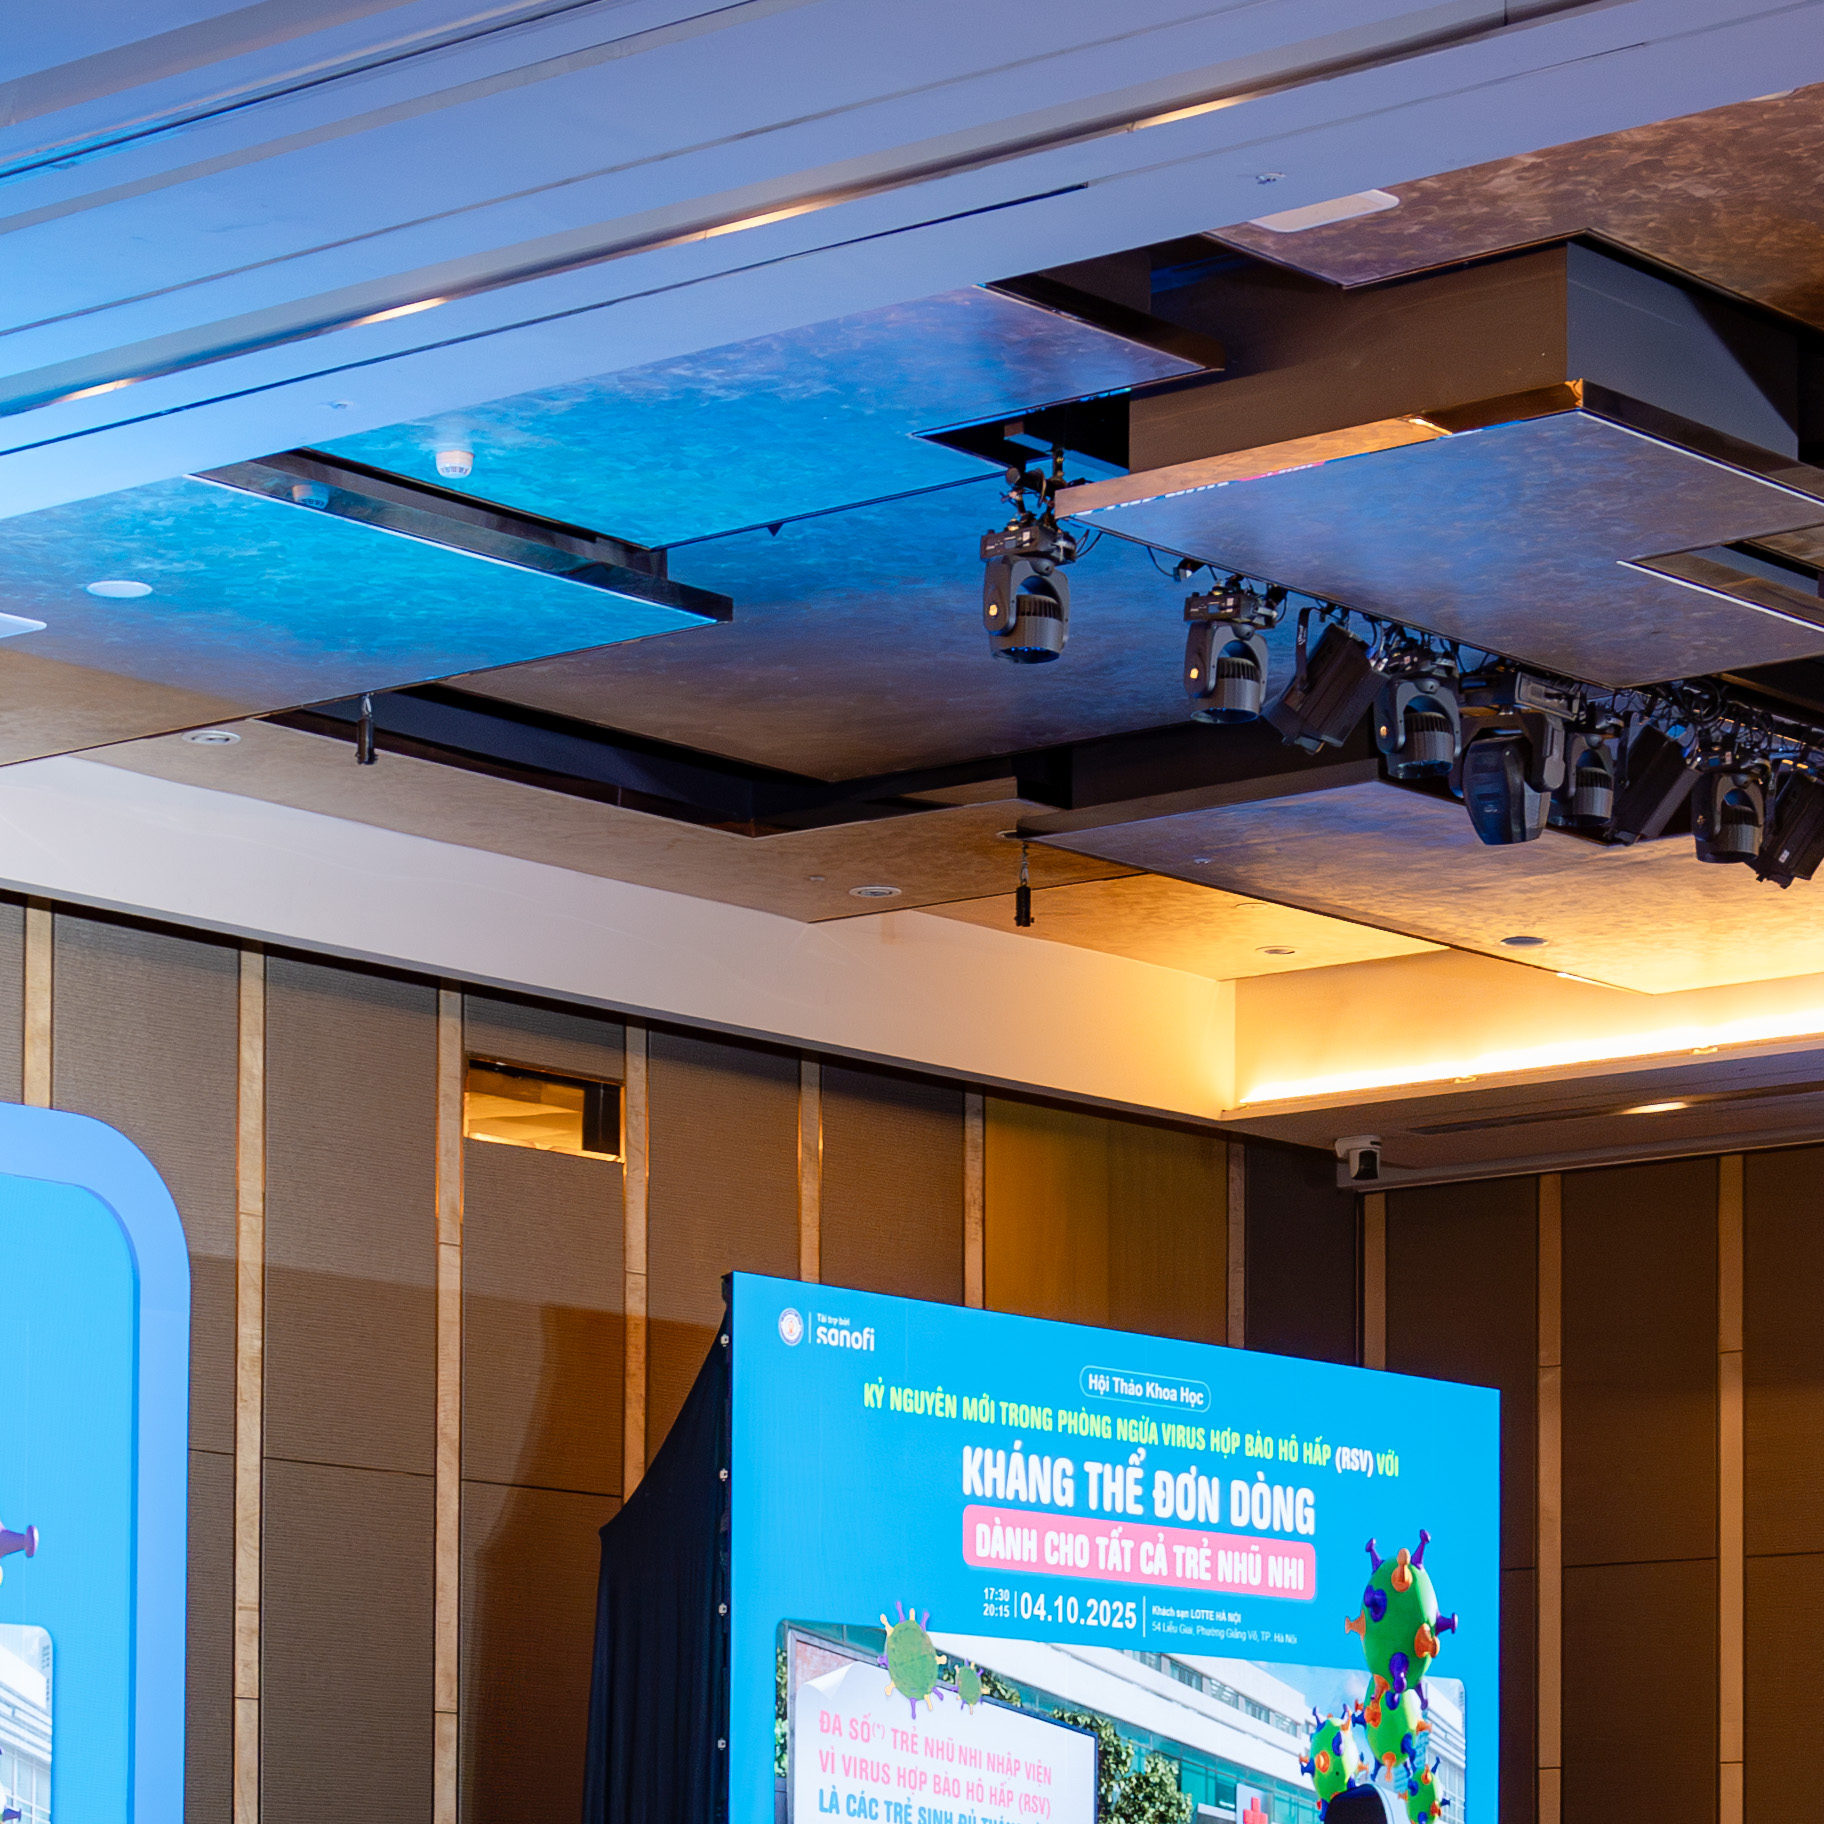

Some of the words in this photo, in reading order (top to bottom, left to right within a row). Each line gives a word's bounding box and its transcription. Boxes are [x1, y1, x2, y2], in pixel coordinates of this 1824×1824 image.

[817, 1326, 875, 1351] sanofi
[1089, 1373, 1110, 1396] Hội
[1112, 1376, 1144, 1397] Thảo
[1146, 1381, 1177, 1401] Khoa
[1180, 1386, 1204, 1408] Học
[890, 1385, 957, 1419] NGUYÊN
[962, 1392, 996, 1424] MỚI
[999, 1401, 1053, 1432] TRONG
[1057, 1406, 1112, 1439] PHÒNG
[1161, 1422, 1206, 1451] VIRUS
[1210, 1426, 1241, 1459] HỢP
[1244, 1429, 1274, 1460] BÀO
[1278, 1433, 1298, 1463] HÔ
[1303, 1435, 1332, 1467] HẤP
[1335, 1445, 1374, 1478] (RSV)
[1376, 1449, 1399, 1477] VỚI
[962, 1439, 1074, 1508] KHÁNG
[1083, 1447, 1146, 1516] THỂ
[1152, 1464, 1220, 1524] ĐƠN
[1230, 1470, 1316, 1536] DÒNG
[975, 1516, 1038, 1563] DÀNH
[1044, 1530, 1090, 1569] CHO
[1095, 1525, 1135, 1573] TẤT
[1139, 1532, 1168, 1577] CẢ
[1173, 1537, 1212, 1582] TRẺ
[1217, 1545, 1262, 1586] NHŨ
[1267, 1555, 1305, 1591] NHI
[983, 1586, 1010, 1602] 17:30
[983, 1602, 1010, 1618] 20:15
[1020, 1591, 1137, 1630] 04.10.2025
[819, 1710, 843, 1738] ĐA
[891, 1726, 919, 1755] TRẺ
[924, 1736, 955, 1763] NHŨ
[958, 1745, 982, 1770] NHI
[987, 1752, 1021, 1781] NHẬP
